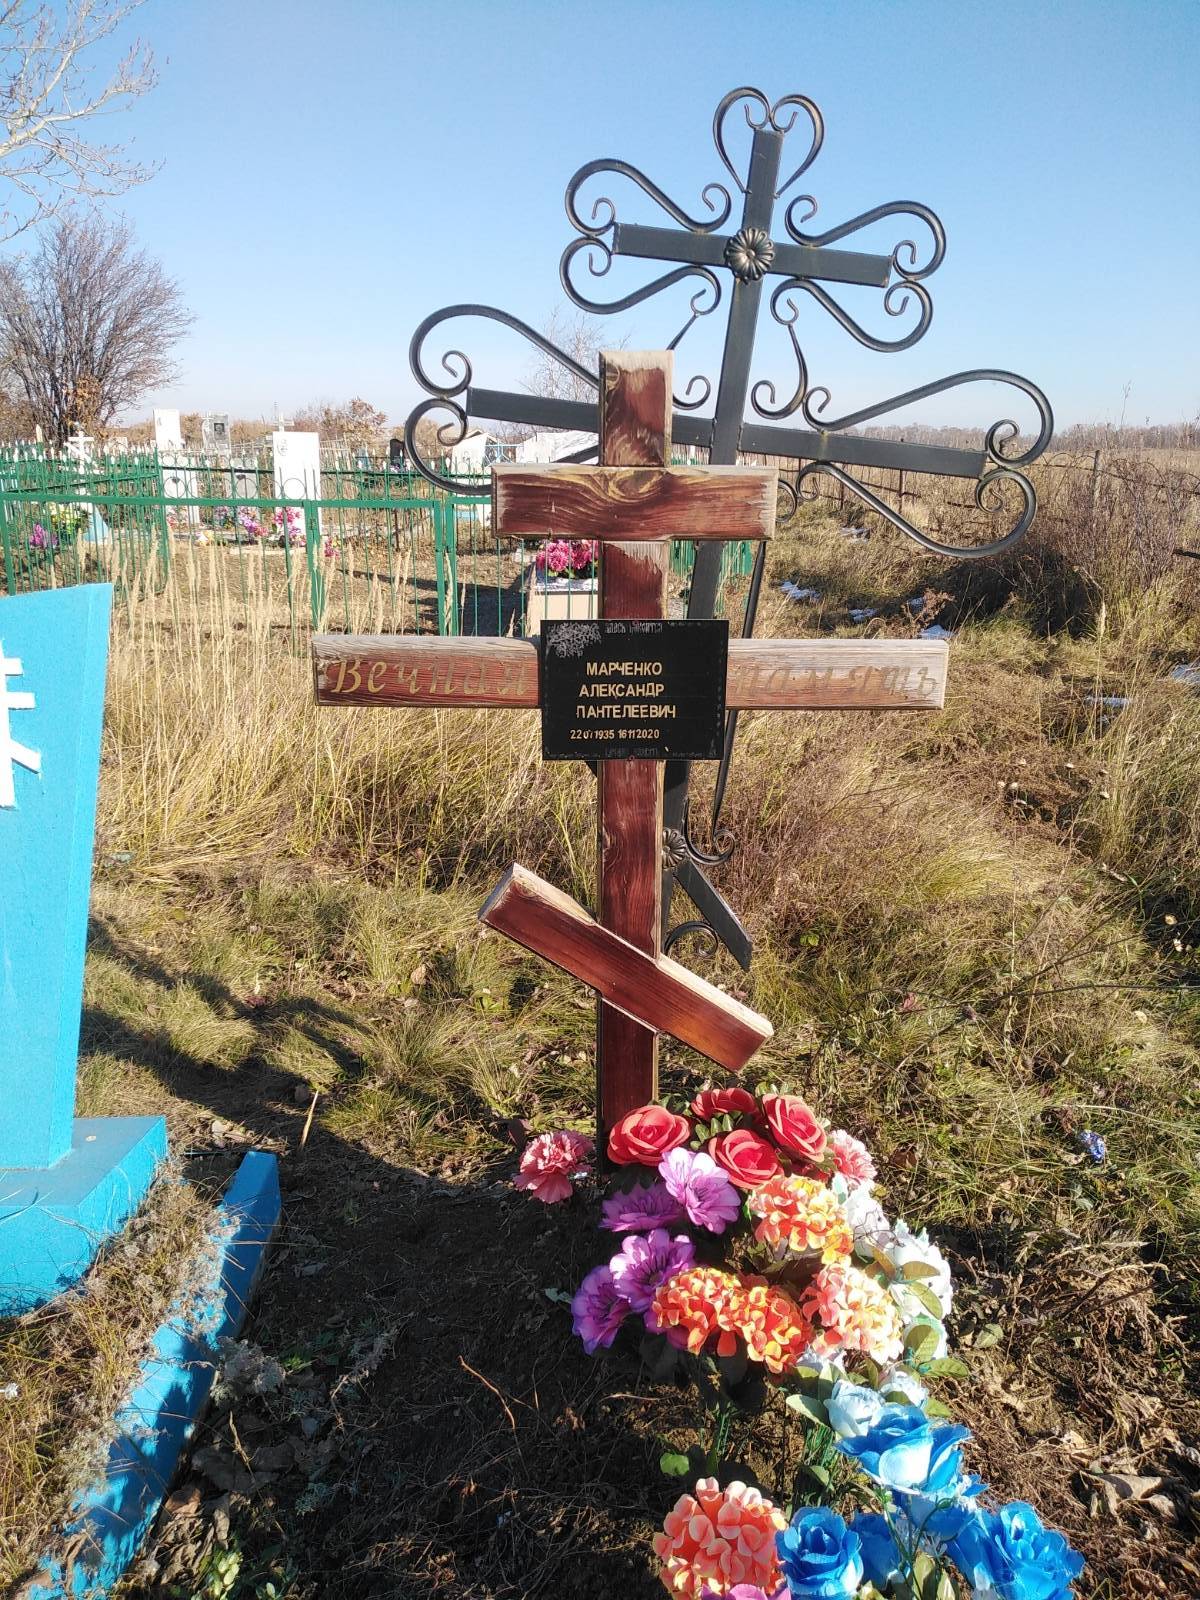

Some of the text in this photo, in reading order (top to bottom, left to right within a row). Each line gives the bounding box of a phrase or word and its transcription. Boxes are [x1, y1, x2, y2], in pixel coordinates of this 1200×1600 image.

[586, 661, 663, 676] МАРЧЕНКО
[579, 682, 665, 698] АЛЕКСАНДР
[576, 705, 677, 719] ПАНТЕЛЕЕВИЧ
